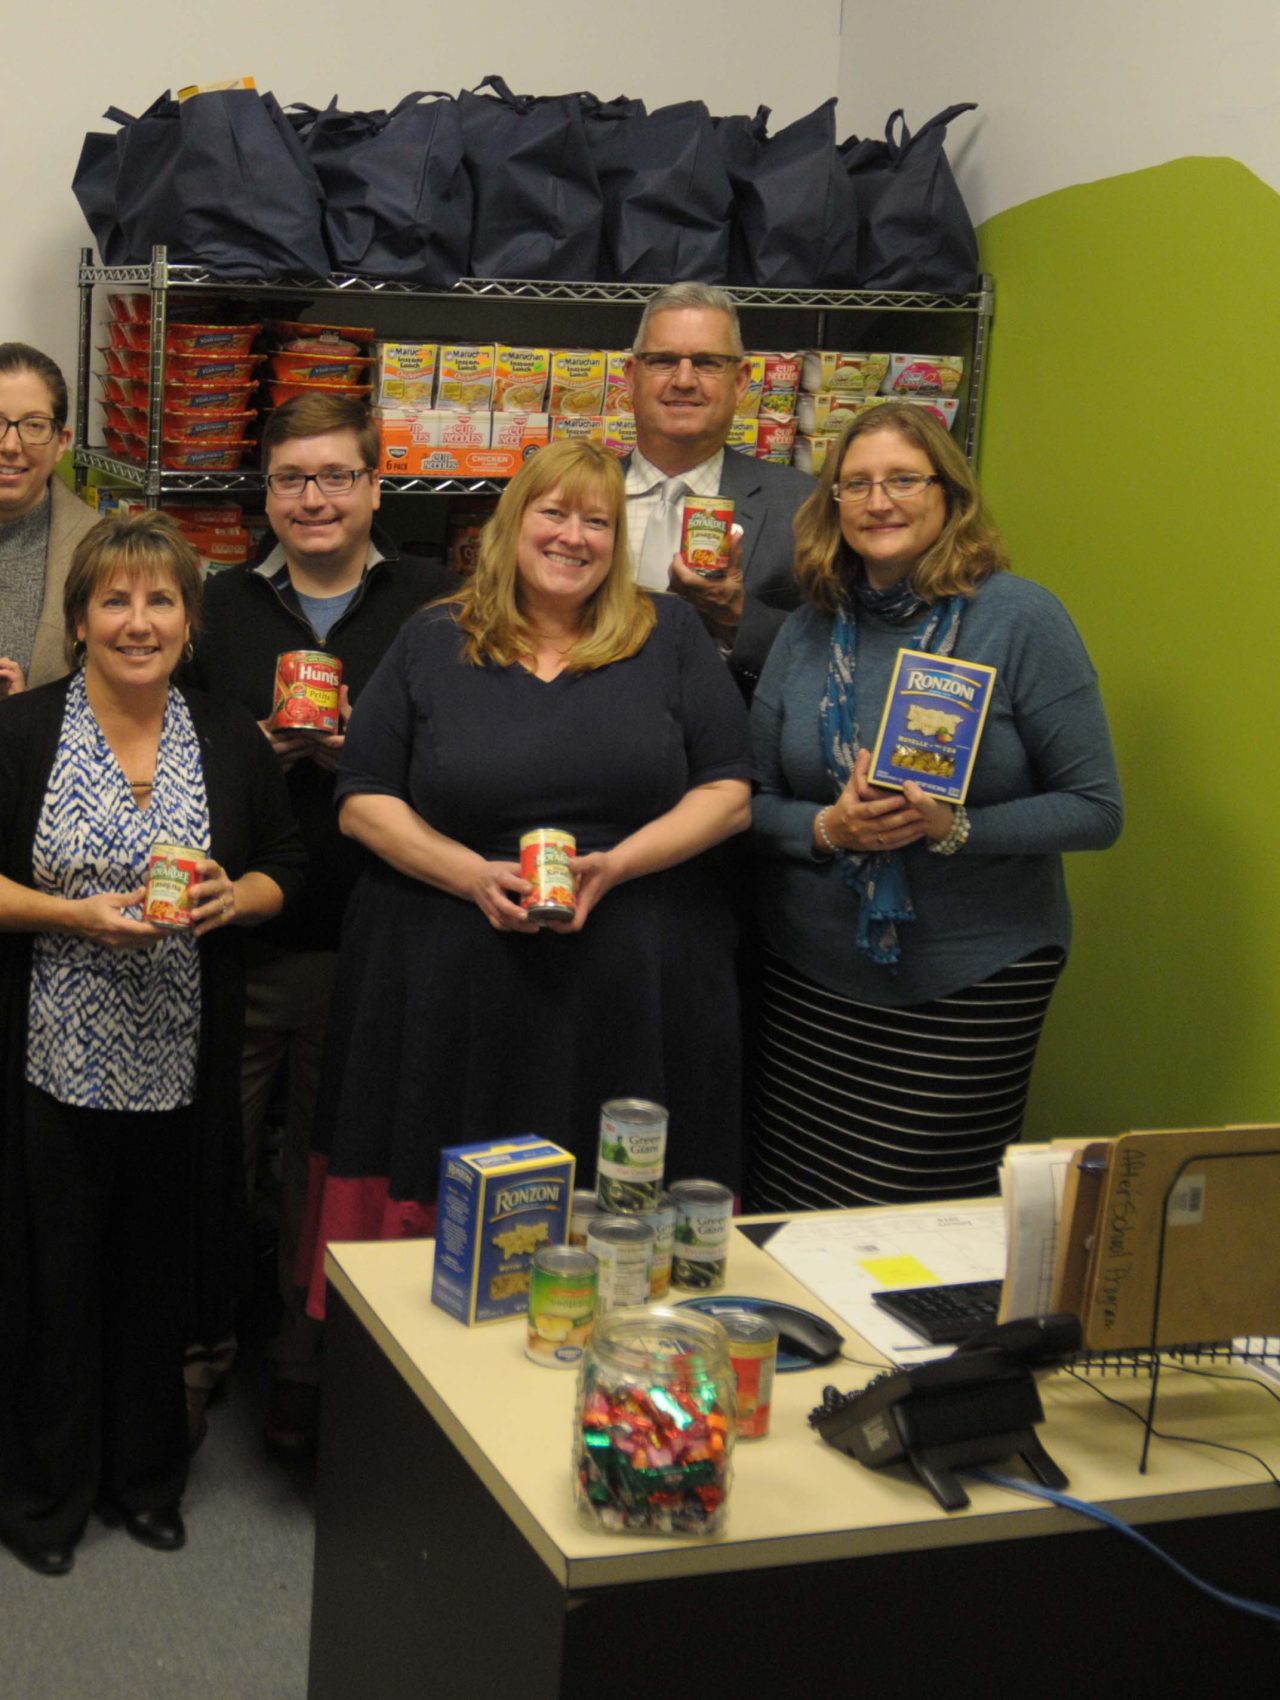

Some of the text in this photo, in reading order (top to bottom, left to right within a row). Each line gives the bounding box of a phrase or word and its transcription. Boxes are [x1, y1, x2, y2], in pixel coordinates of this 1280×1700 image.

[395, 347, 433, 357] Marucn
[507, 351, 544, 361] Maruchan
[564, 358, 601, 367] Maruchan
[564, 419, 601, 428] Maruchan
[472, 455, 509, 463] CHICKEN
[385, 459, 408, 471] 6 PACK
[908, 671, 975, 701] RONZONI
[495, 1186, 559, 1214] RONZONI
